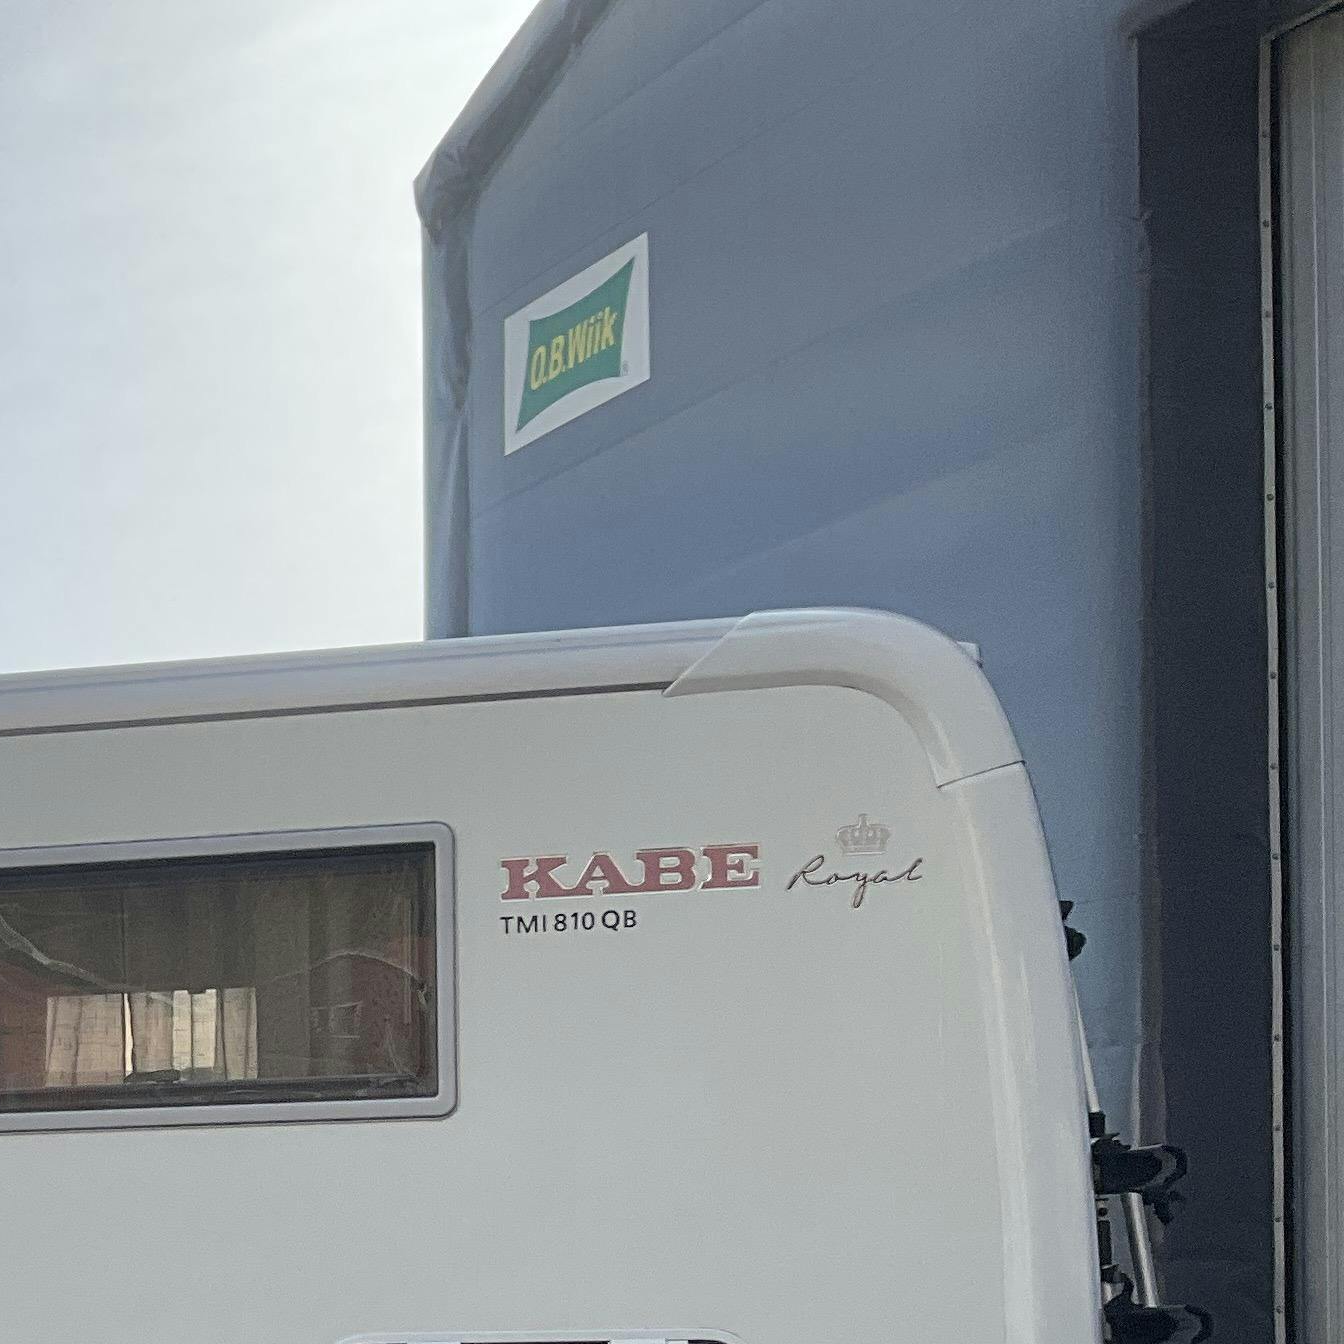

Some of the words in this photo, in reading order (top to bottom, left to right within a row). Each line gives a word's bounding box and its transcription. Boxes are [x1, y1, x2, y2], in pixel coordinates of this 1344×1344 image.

[500, 844, 759, 900] KABE
[785, 854, 923, 908] Royal
[500, 915, 546, 934] TMI
[554, 912, 595, 931] 810
[601, 910, 637, 931] QB
